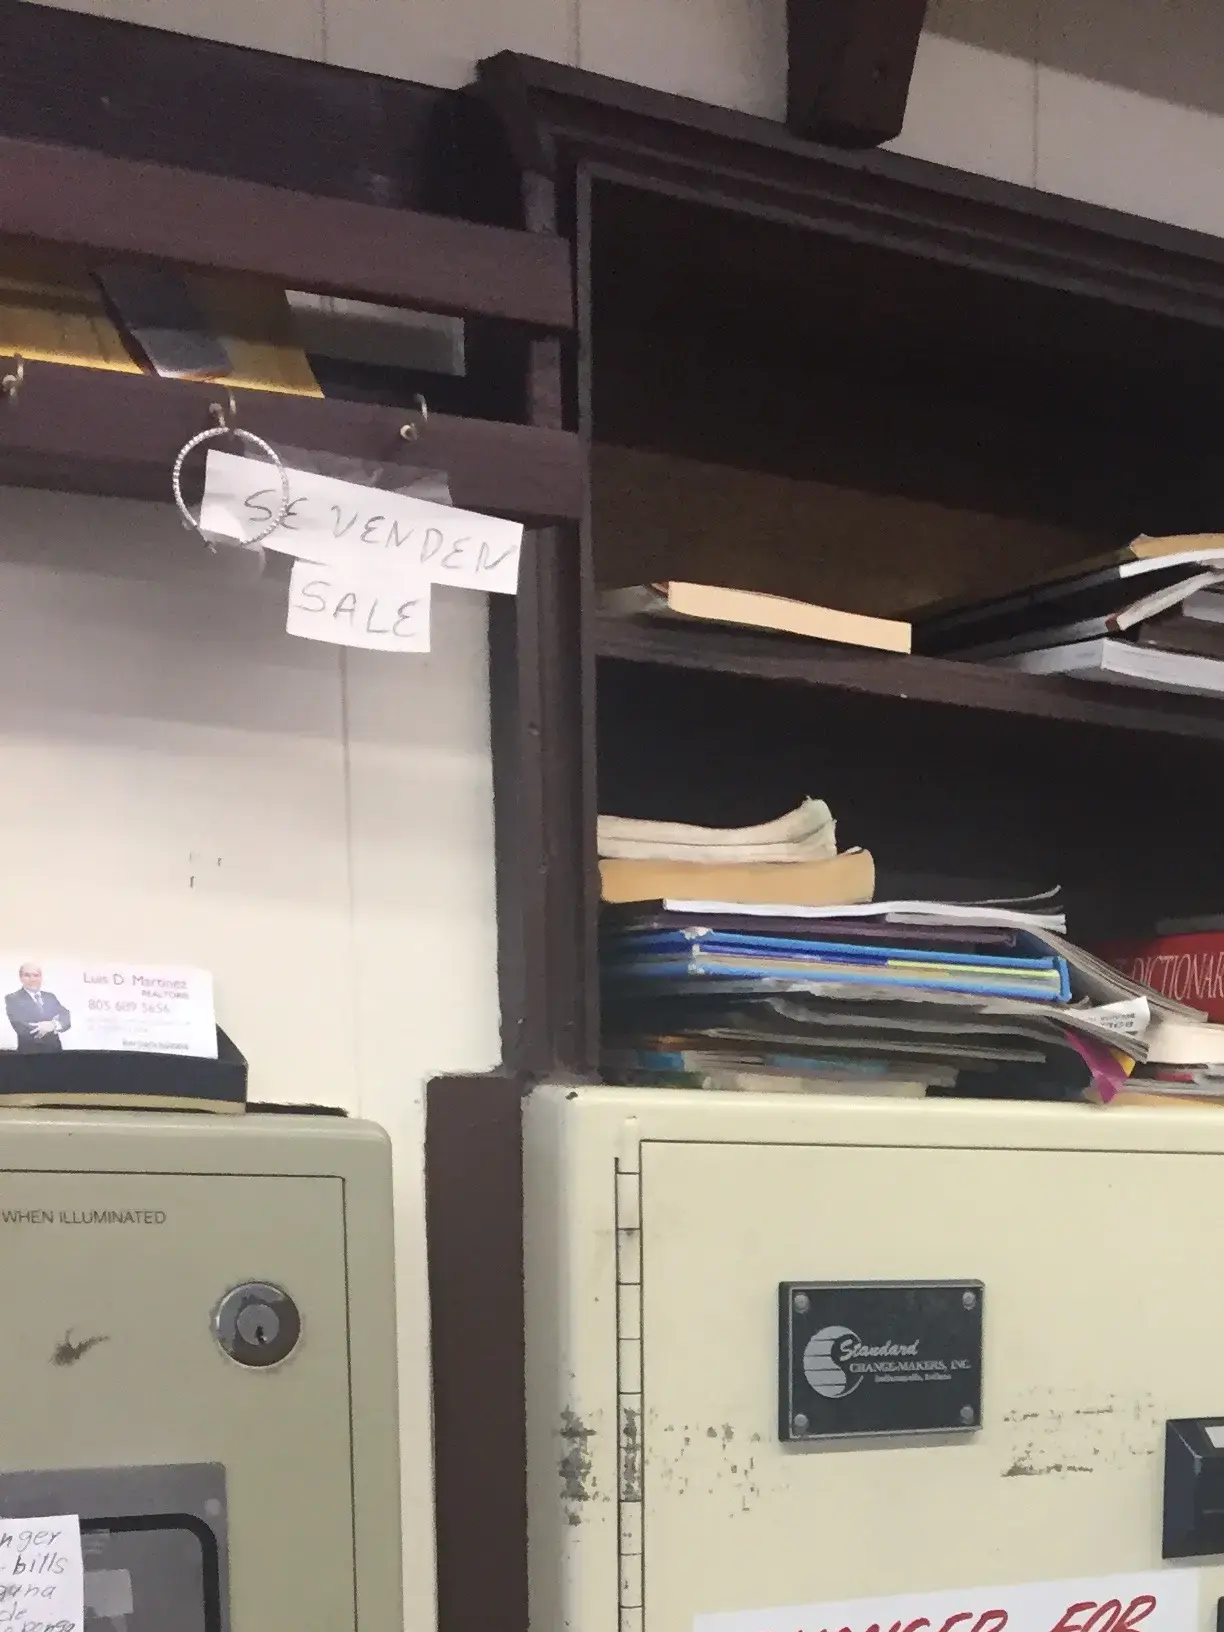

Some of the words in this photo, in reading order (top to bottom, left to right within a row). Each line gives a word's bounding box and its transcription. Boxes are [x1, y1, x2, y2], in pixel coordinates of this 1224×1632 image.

[331, 504, 518, 572] VENDEN
[296, 580, 420, 637] SALE
[83, 972, 109, 985] Luis
[2, 1209, 54, 1225] WHEN
[59, 1209, 167, 1226] ILLUMINATED
[840, 1338, 920, 1362] Standard
[12, 1552, 68, 1576] bills
